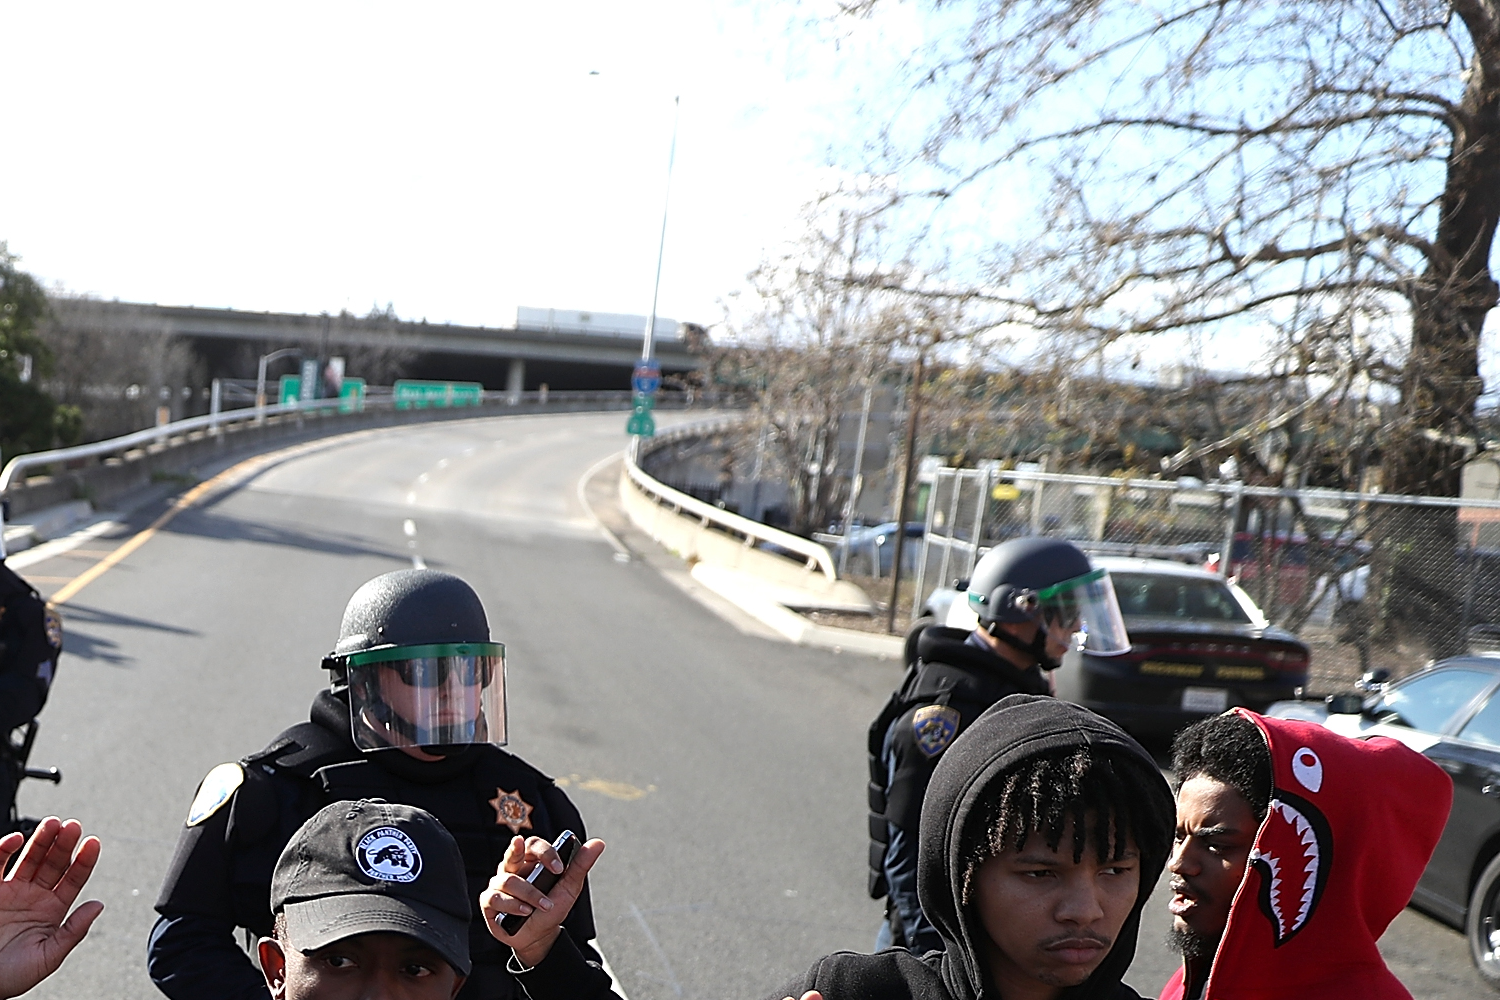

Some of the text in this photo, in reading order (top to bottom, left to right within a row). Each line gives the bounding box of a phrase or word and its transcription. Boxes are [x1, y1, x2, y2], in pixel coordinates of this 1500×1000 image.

[359, 829, 418, 855] BLACK PANTHER PARTY
